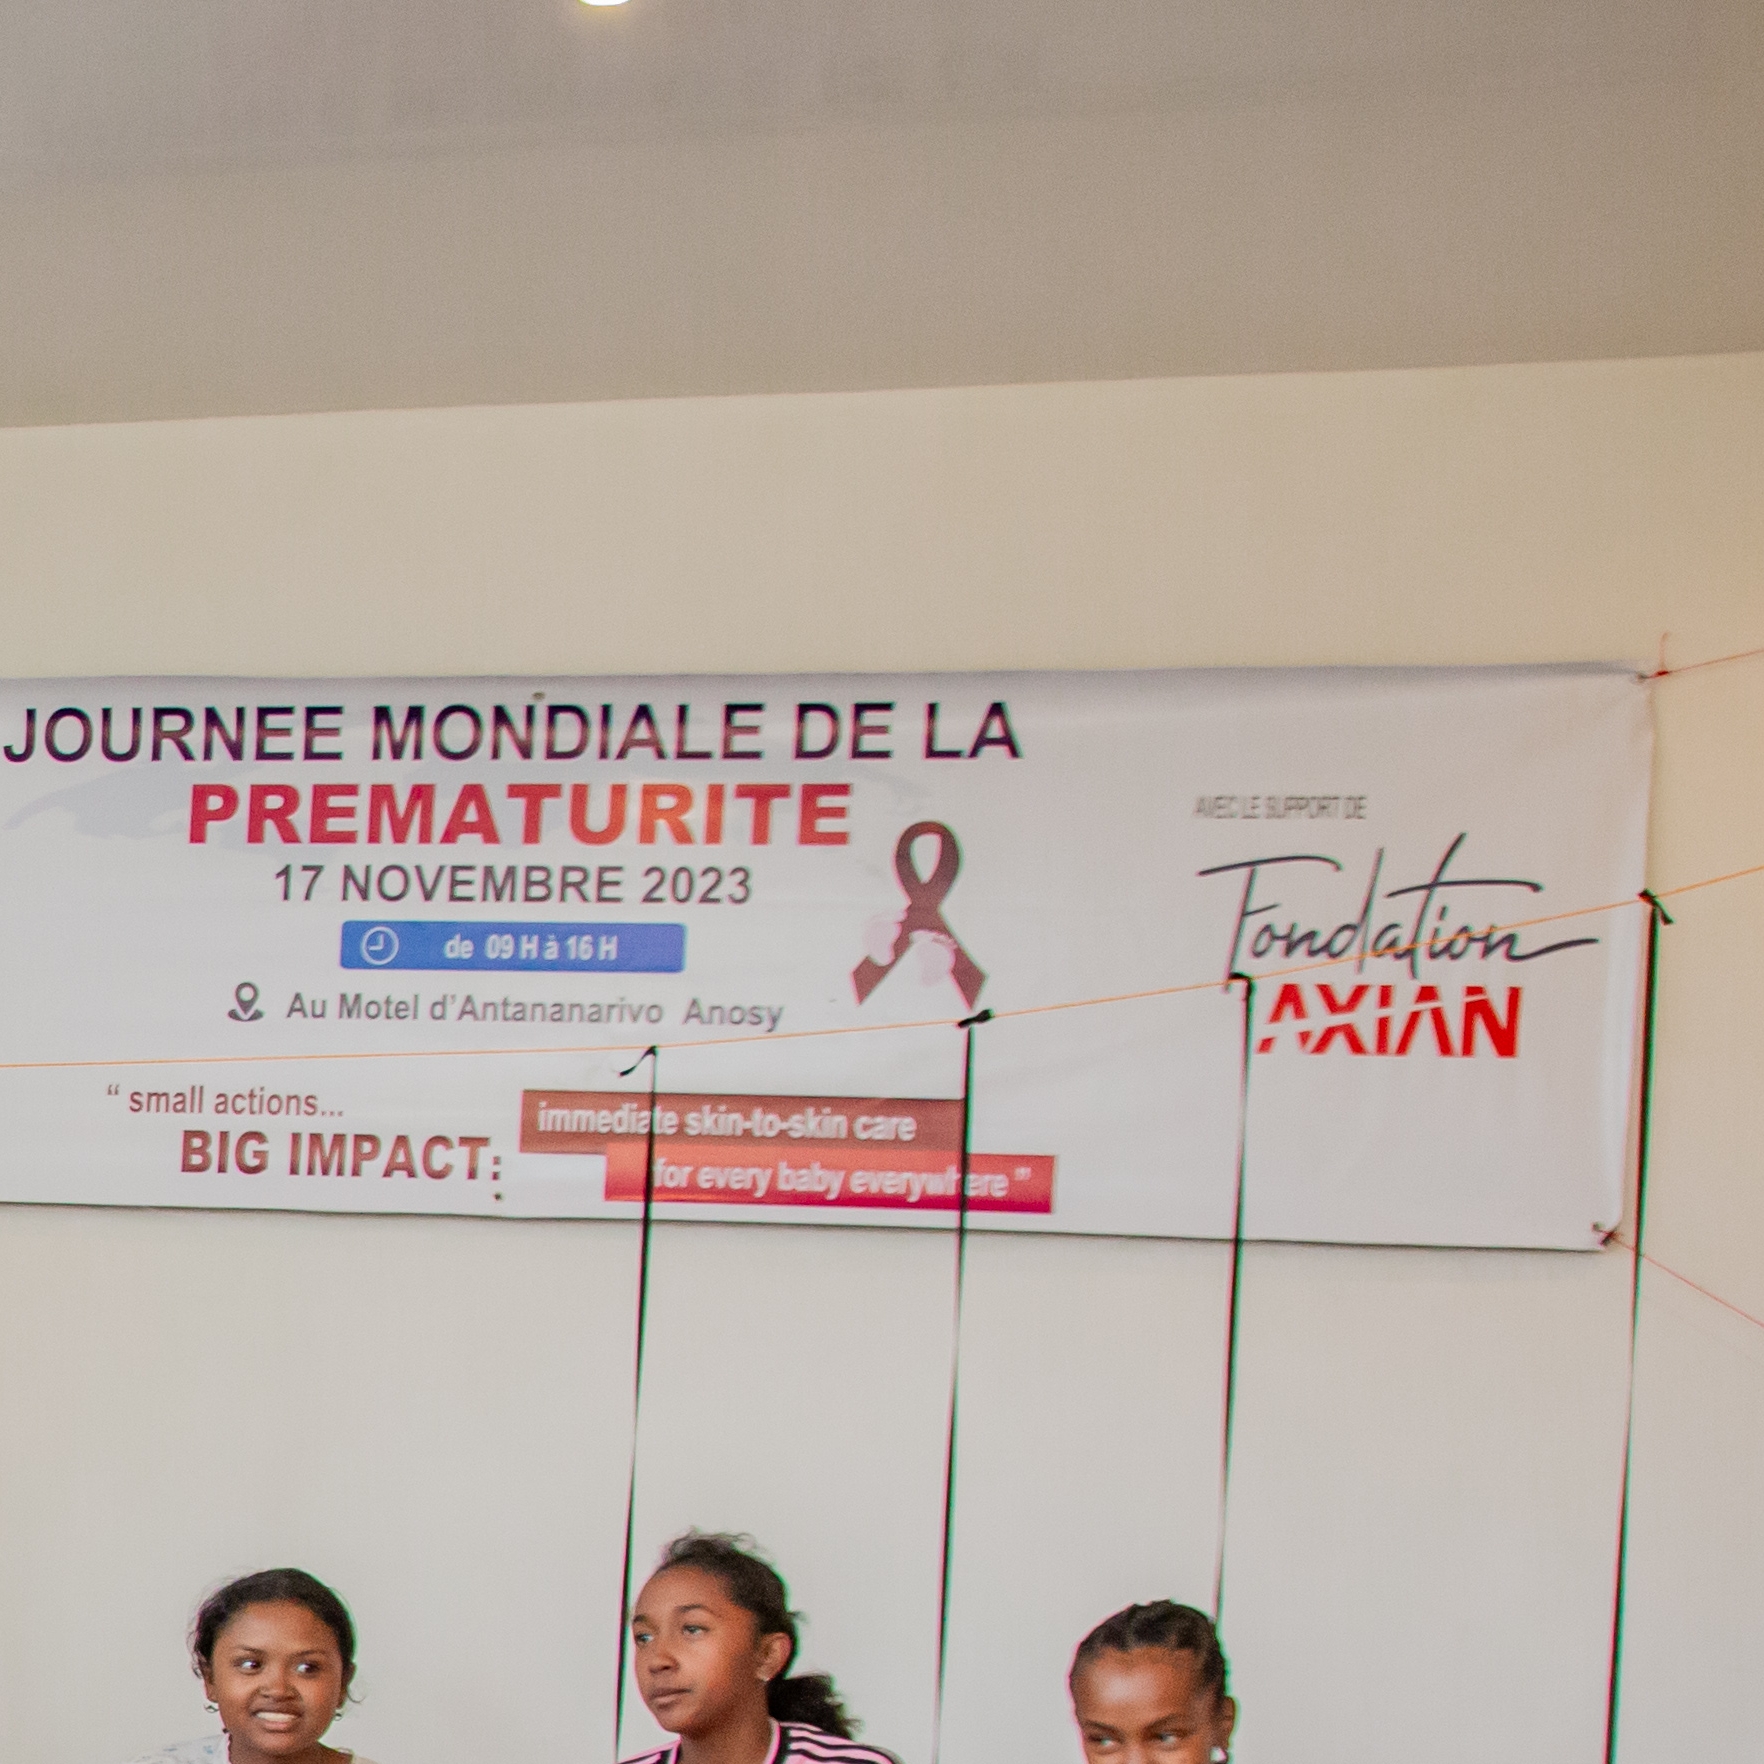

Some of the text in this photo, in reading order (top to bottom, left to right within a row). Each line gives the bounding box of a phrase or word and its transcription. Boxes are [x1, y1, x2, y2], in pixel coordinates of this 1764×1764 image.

[3, 701, 1024, 764] JOURNEE MONDIALE DE LA
[188, 783, 853, 846] PREMATURITE
[274, 864, 753, 904] 17 NOVEMBRE 2023
[1196, 832, 1600, 994] Fondation
[444, 933, 475, 960] de
[485, 933, 515, 960] 09
[519, 934, 540, 960] H
[566, 934, 594, 961] 16
[597, 935, 619, 961] H
[286, 992, 326, 1021] Au
[338, 993, 419, 1022] Motel
[682, 997, 785, 1032] Anosy
[1254, 983, 1524, 1060] AXIAN
[128, 1085, 205, 1114] small
[214, 1086, 344, 1117] actions...
[536, 1101, 917, 1142] immediate skin-to-skin care
[180, 1129, 269, 1175] BIG
[652, 1158, 693, 1189] for
[696, 1163, 773, 1198] every
[777, 1161, 847, 1201] baby
[849, 1164, 1010, 1203] everywhere
